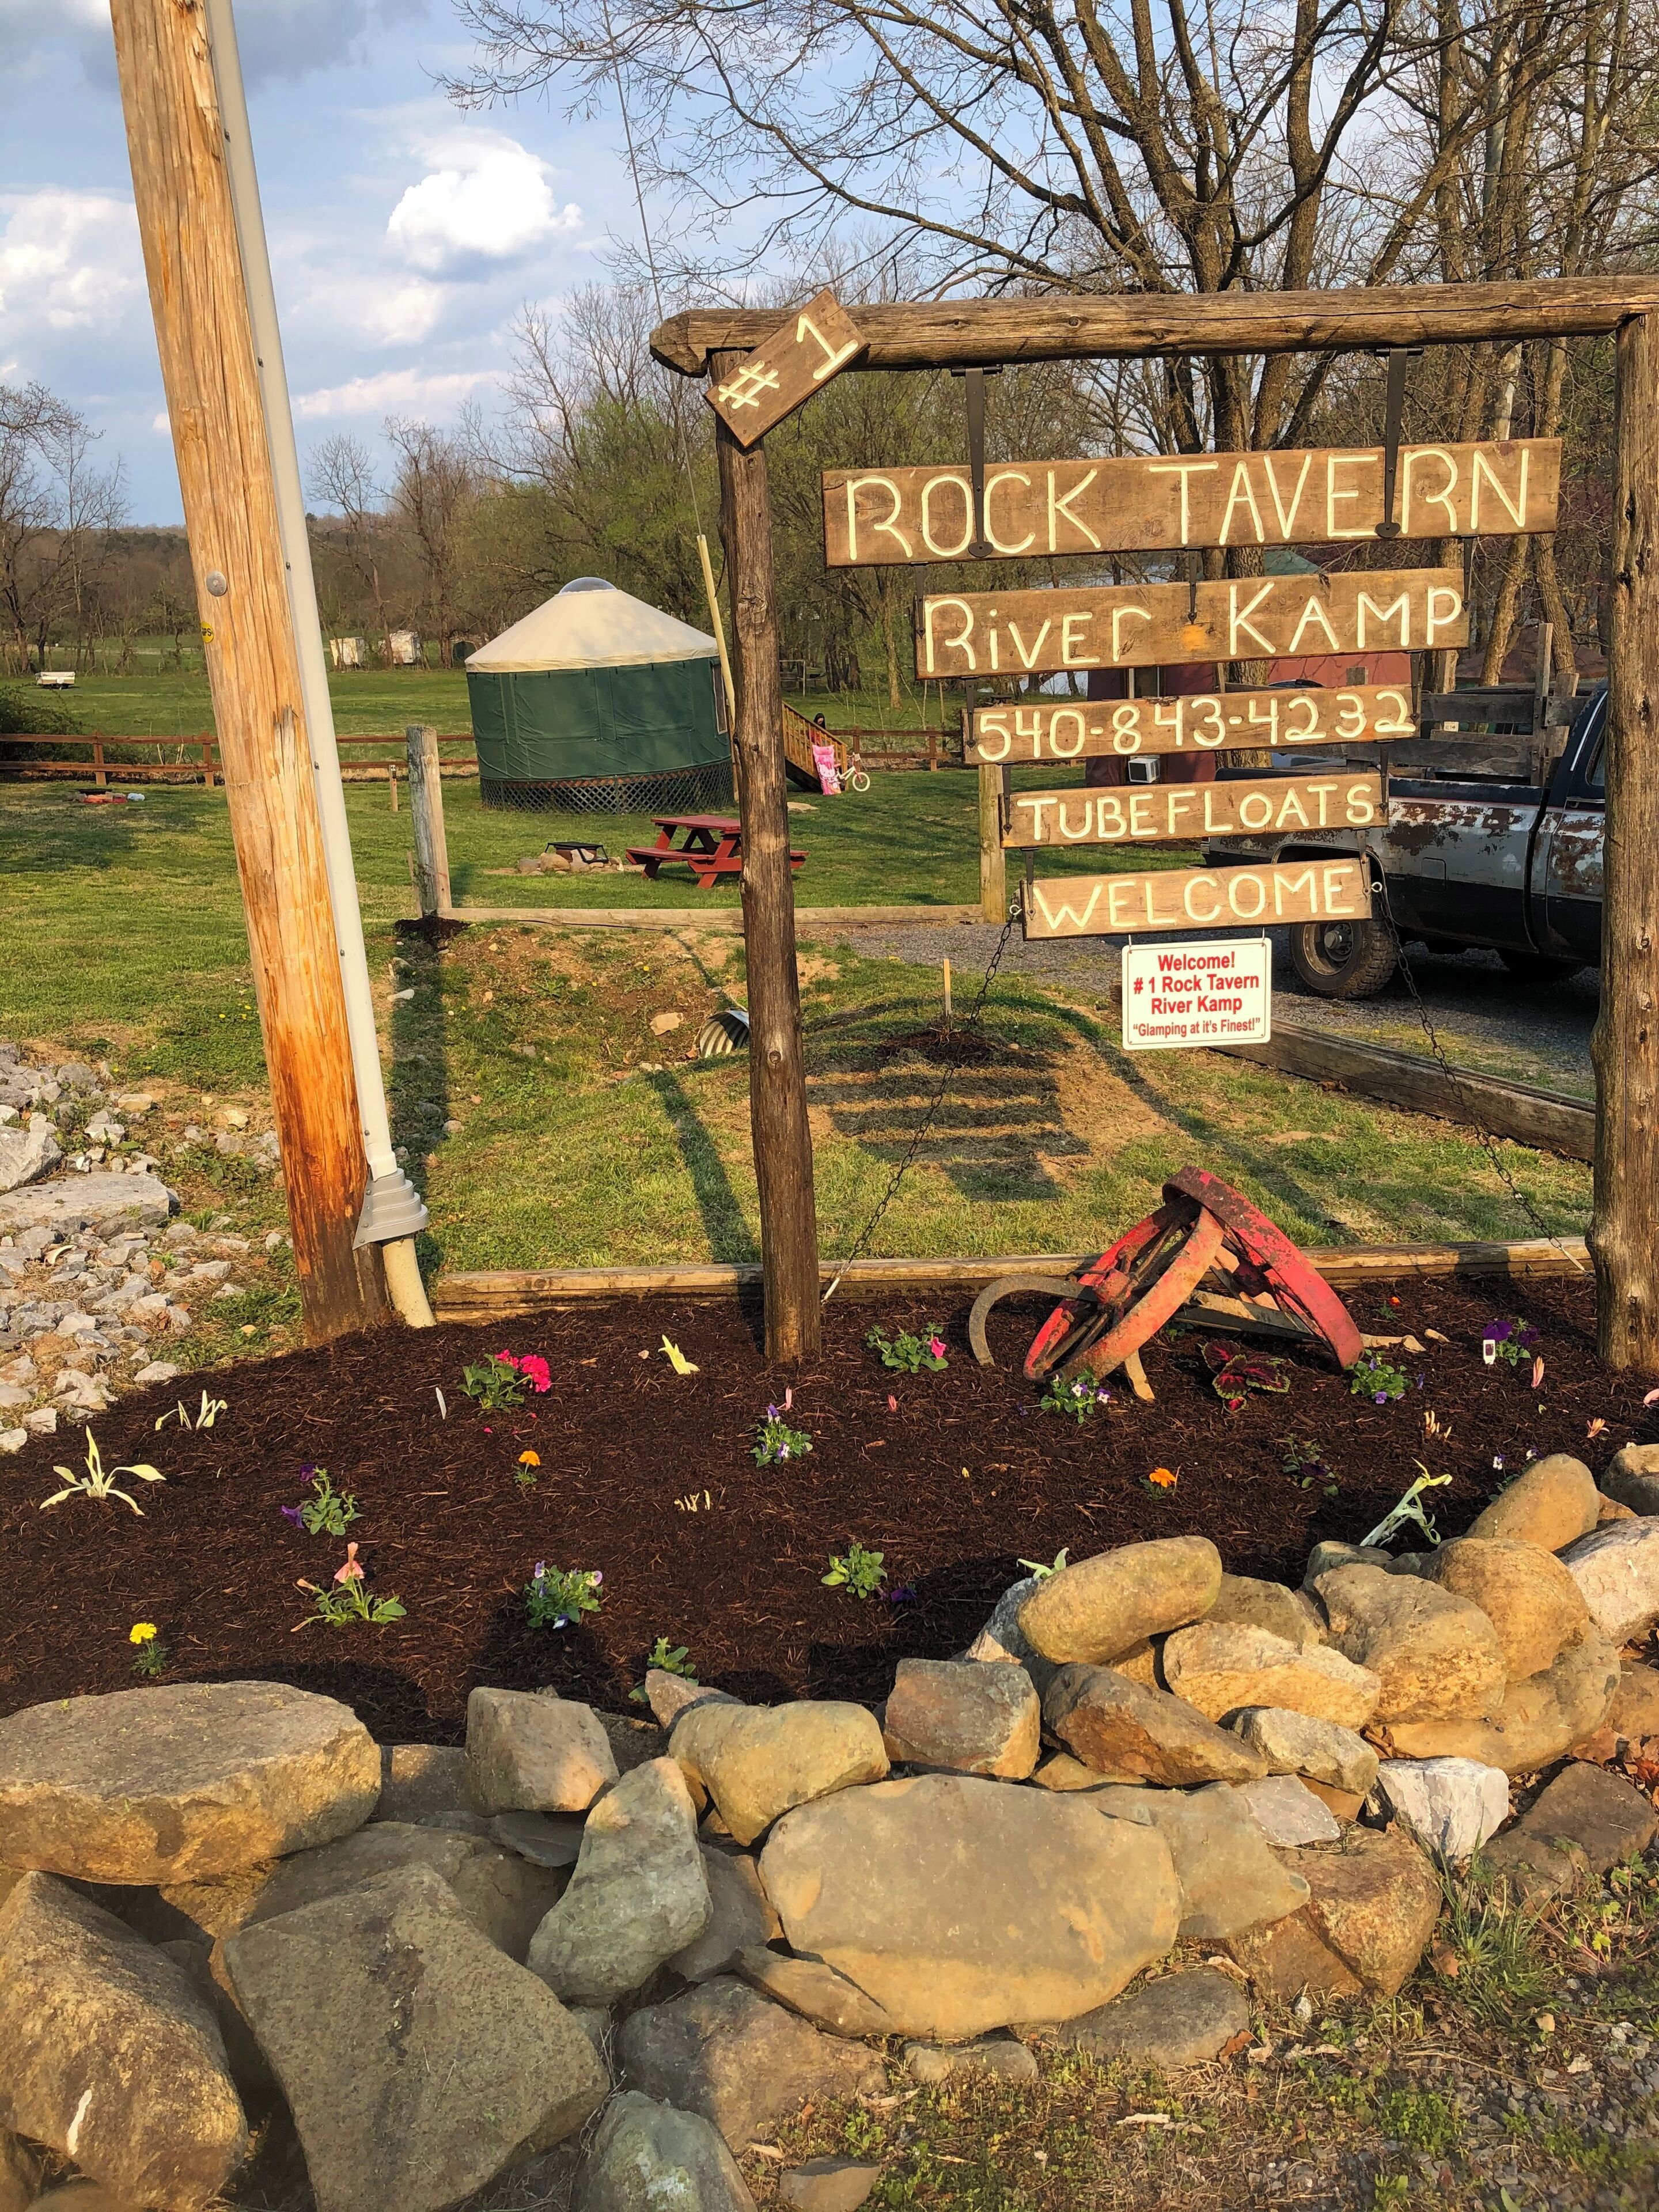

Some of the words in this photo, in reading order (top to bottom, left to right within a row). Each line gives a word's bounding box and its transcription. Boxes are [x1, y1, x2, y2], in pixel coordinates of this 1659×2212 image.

[846, 468, 1101, 560] ROCK
[1148, 447, 1530, 546] TAVERN
[1229, 581, 1462, 656] KAMP
[976, 690, 1416, 762] 540-843-4232
[1032, 865, 1355, 933] WELCOME
[1157, 951, 1236, 972] Welcome!
[1162, 975, 1202, 993] Rock
[1206, 973, 1260, 991] Tavern
[1151, 997, 1193, 1014] River
[1197, 995, 1243, 1015] Kamp
[1190, 1022, 1200, 1035] at
